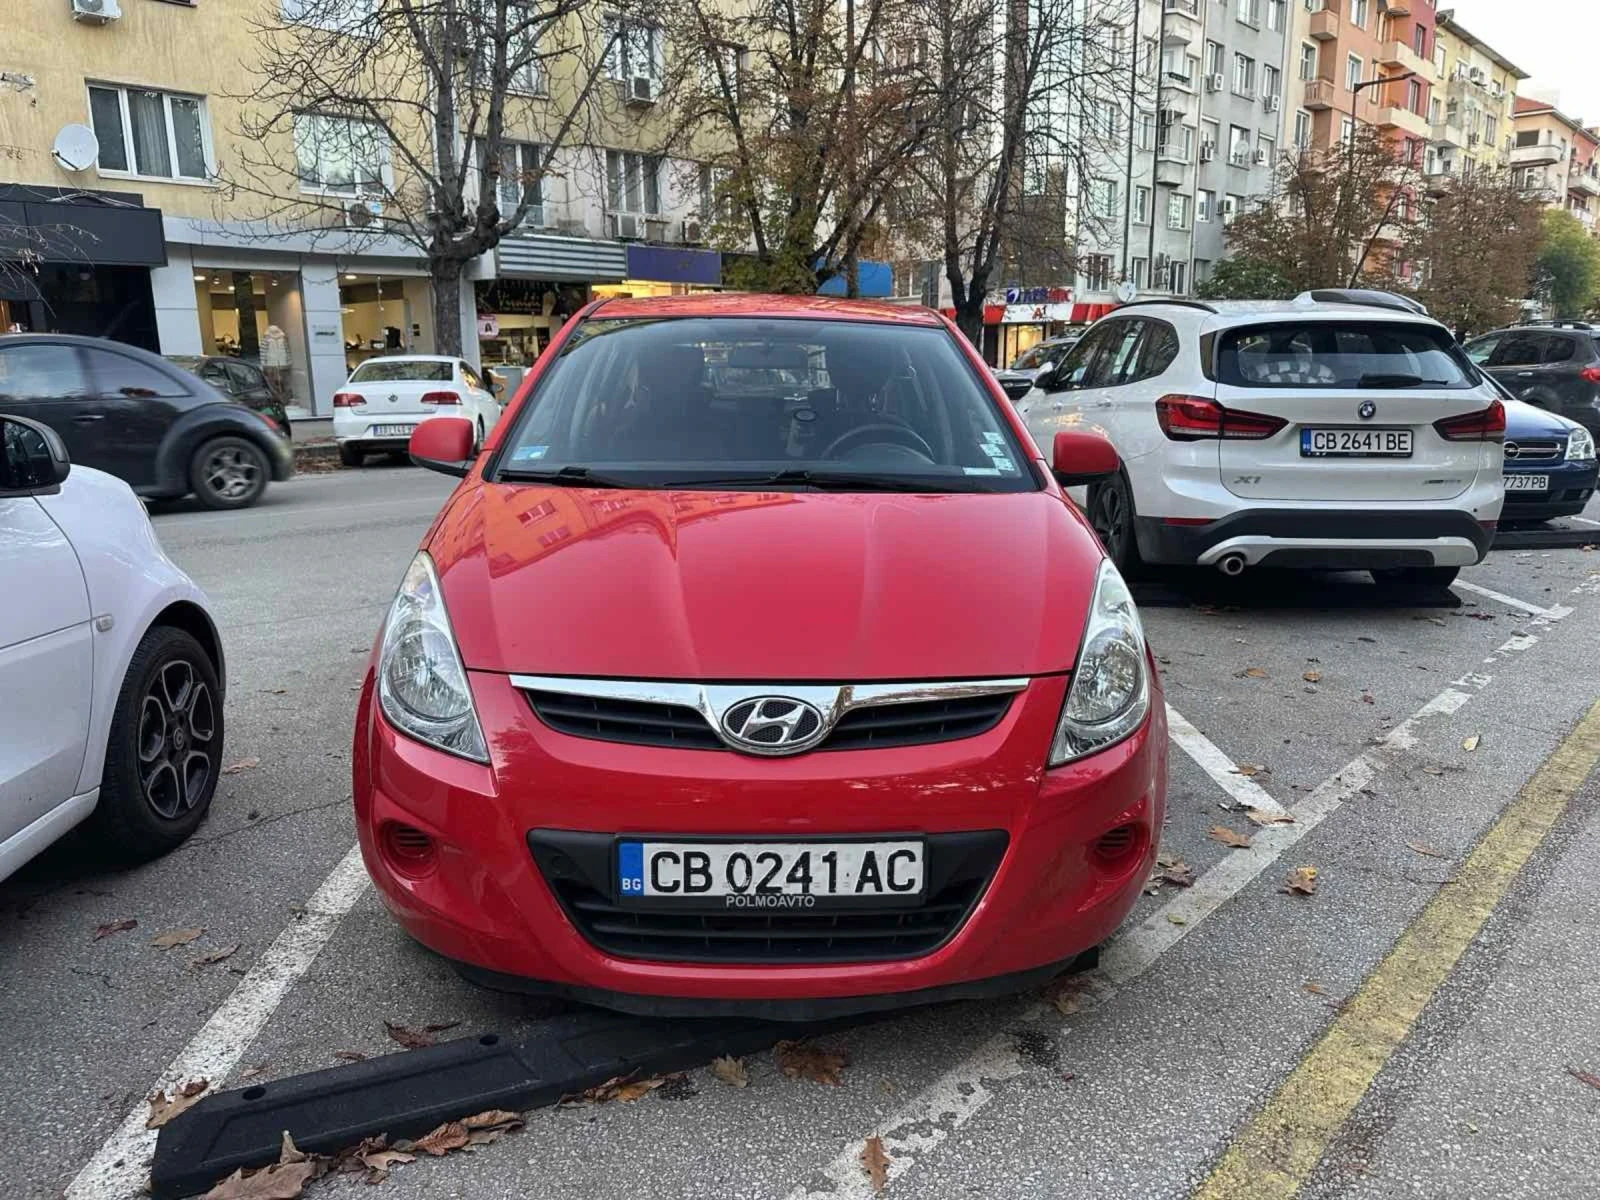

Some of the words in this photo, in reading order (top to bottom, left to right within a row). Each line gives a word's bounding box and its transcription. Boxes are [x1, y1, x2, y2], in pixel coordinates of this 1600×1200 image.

[1032, 304, 1047, 320] A1
[1314, 432, 1337, 450] CB
[1340, 432, 1381, 450] 2641
[1386, 433, 1409, 451] BE
[1503, 476, 1530, 488] 7737
[1531, 476, 1546, 489] PB
[622, 878, 641, 891] BG
[650, 851, 713, 893] CB
[725, 850, 837, 894] 0241
[855, 849, 917, 893] AC
[725, 894, 816, 908] POLMOAVTO
